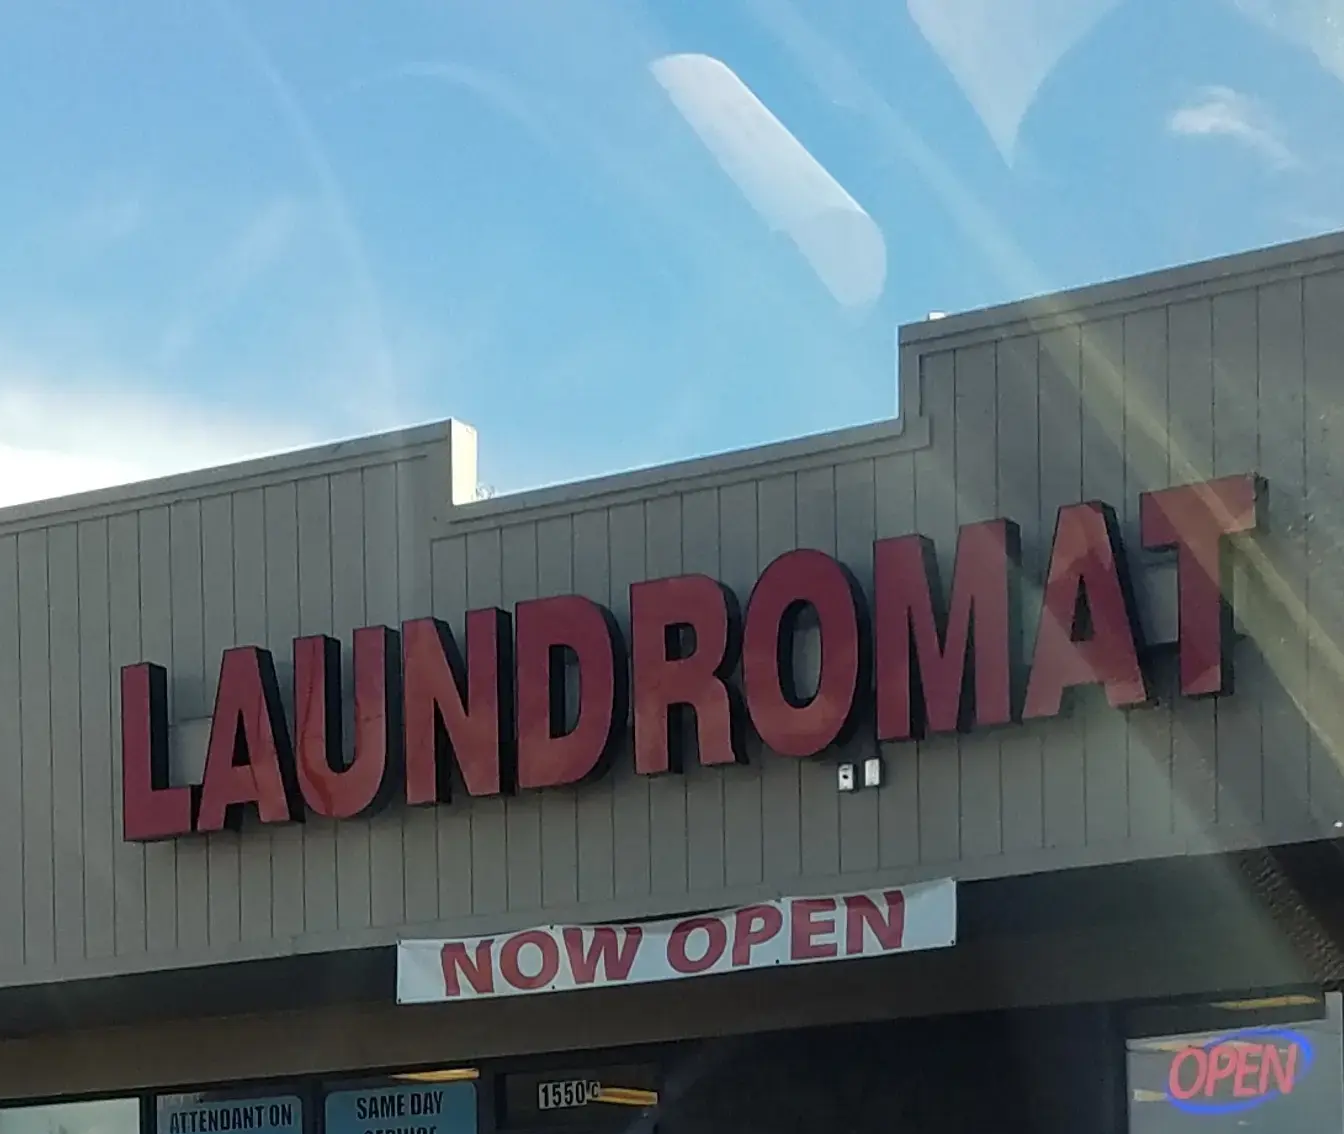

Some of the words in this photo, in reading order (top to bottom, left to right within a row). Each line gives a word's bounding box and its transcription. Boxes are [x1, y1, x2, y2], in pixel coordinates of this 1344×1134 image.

[119, 473, 1269, 841] LAUNDROMAT
[441, 926, 643, 998] NOW
[666, 889, 906, 974] OPEN
[1169, 1043, 1299, 1100] OPEN
[168, 1104, 265, 1134] ATTENDANT
[269, 1102, 293, 1128] ON
[356, 1093, 405, 1121] SAME
[410, 1090, 444, 1117] DAY
